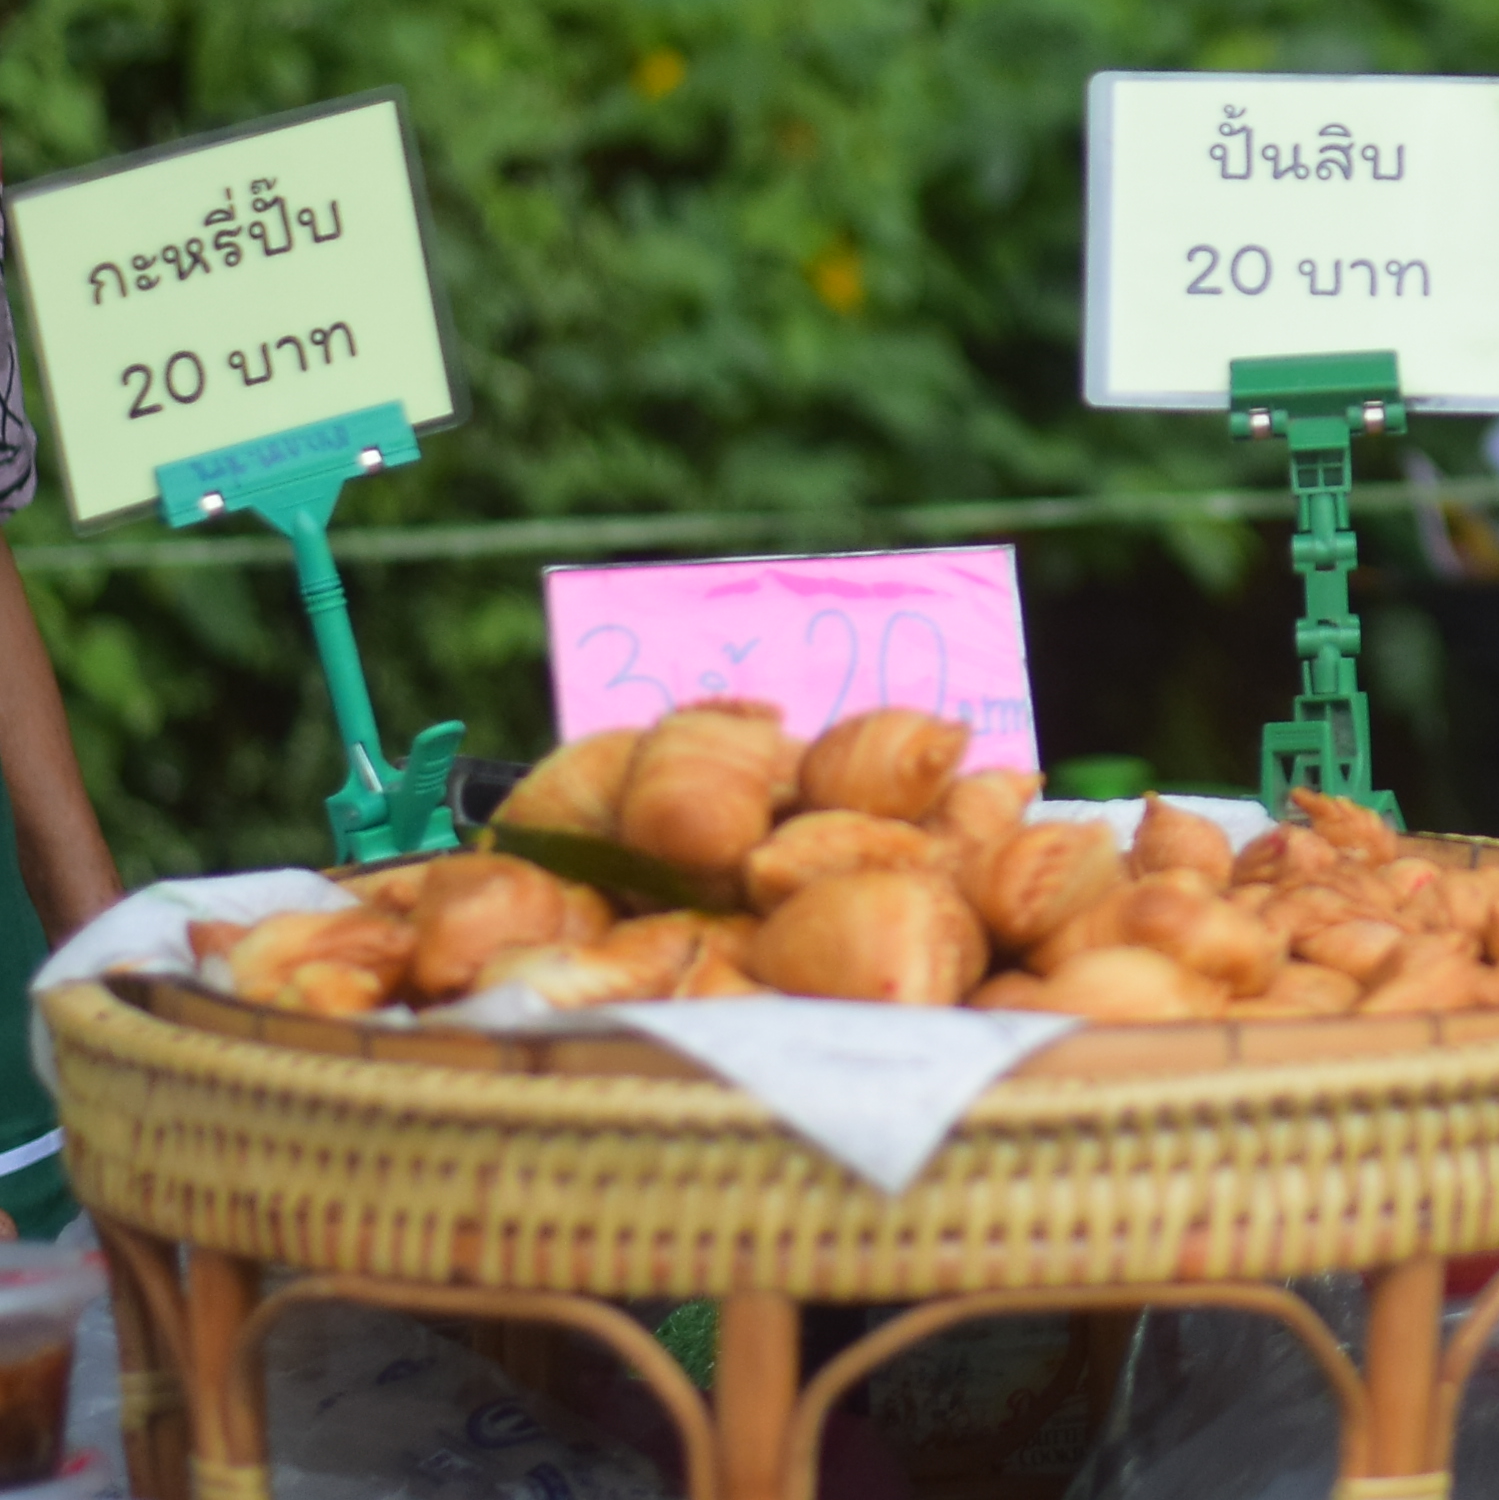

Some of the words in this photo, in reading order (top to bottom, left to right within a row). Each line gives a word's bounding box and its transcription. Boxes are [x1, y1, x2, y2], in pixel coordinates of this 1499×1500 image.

[1209, 103, 1406, 182] ปั้นสิบ
[87, 177, 344, 305] กะหรี่ปั๊บ
[1185, 243, 1273, 296] 20
[1298, 257, 1432, 297] บาท
[120, 350, 207, 420] 20
[227, 320, 358, 387] บาท
[576, 623, 676, 714] 3
[806, 608, 949, 734] 20
